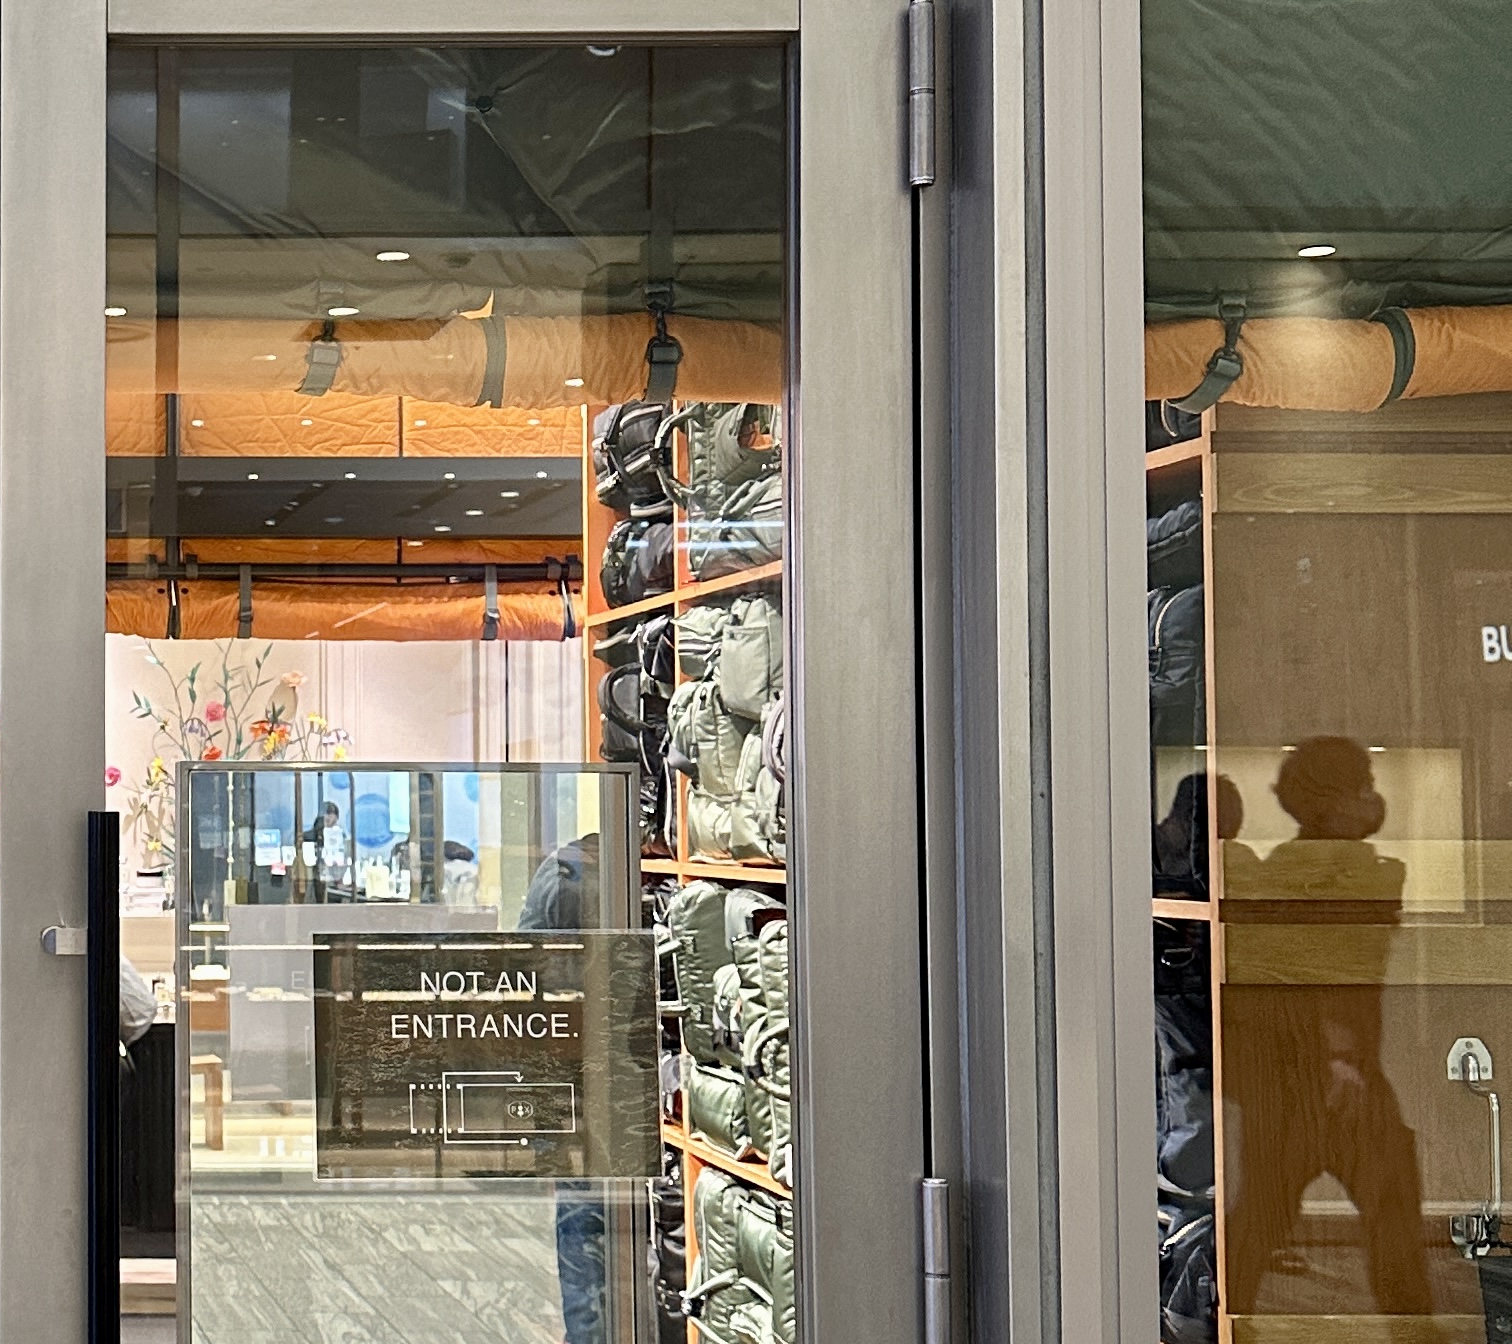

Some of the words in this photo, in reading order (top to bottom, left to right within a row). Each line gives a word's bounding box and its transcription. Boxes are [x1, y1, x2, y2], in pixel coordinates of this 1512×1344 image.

[420, 971, 485, 997] NOT
[496, 970, 538, 996] AN
[390, 1012, 579, 1040] ENTRANCE.
